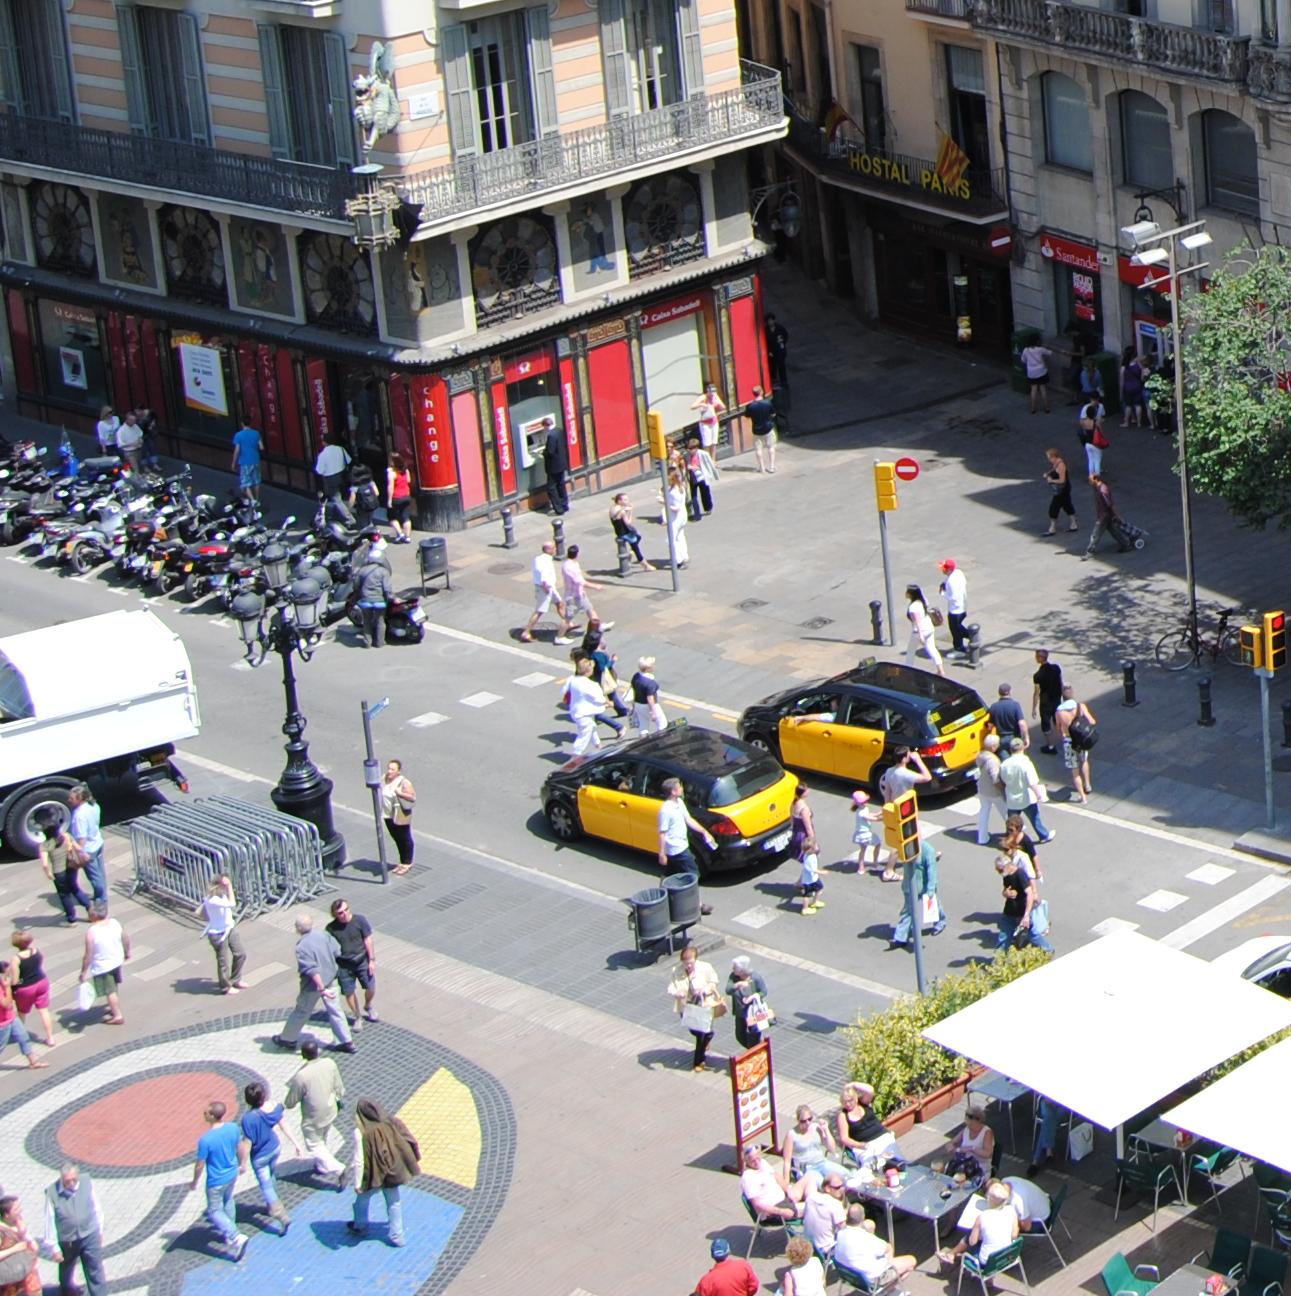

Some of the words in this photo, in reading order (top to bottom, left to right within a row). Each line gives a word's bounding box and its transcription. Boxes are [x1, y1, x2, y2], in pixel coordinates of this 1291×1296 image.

[850, 151, 911, 186] HOSTAL
[1056, 247, 1099, 272] Santander
[651, 311, 671, 322] Caixa
[671, 299, 701, 315] Sabadell
[495, 406, 508, 444] Sabadell
[502, 444, 511, 471] Caixa
